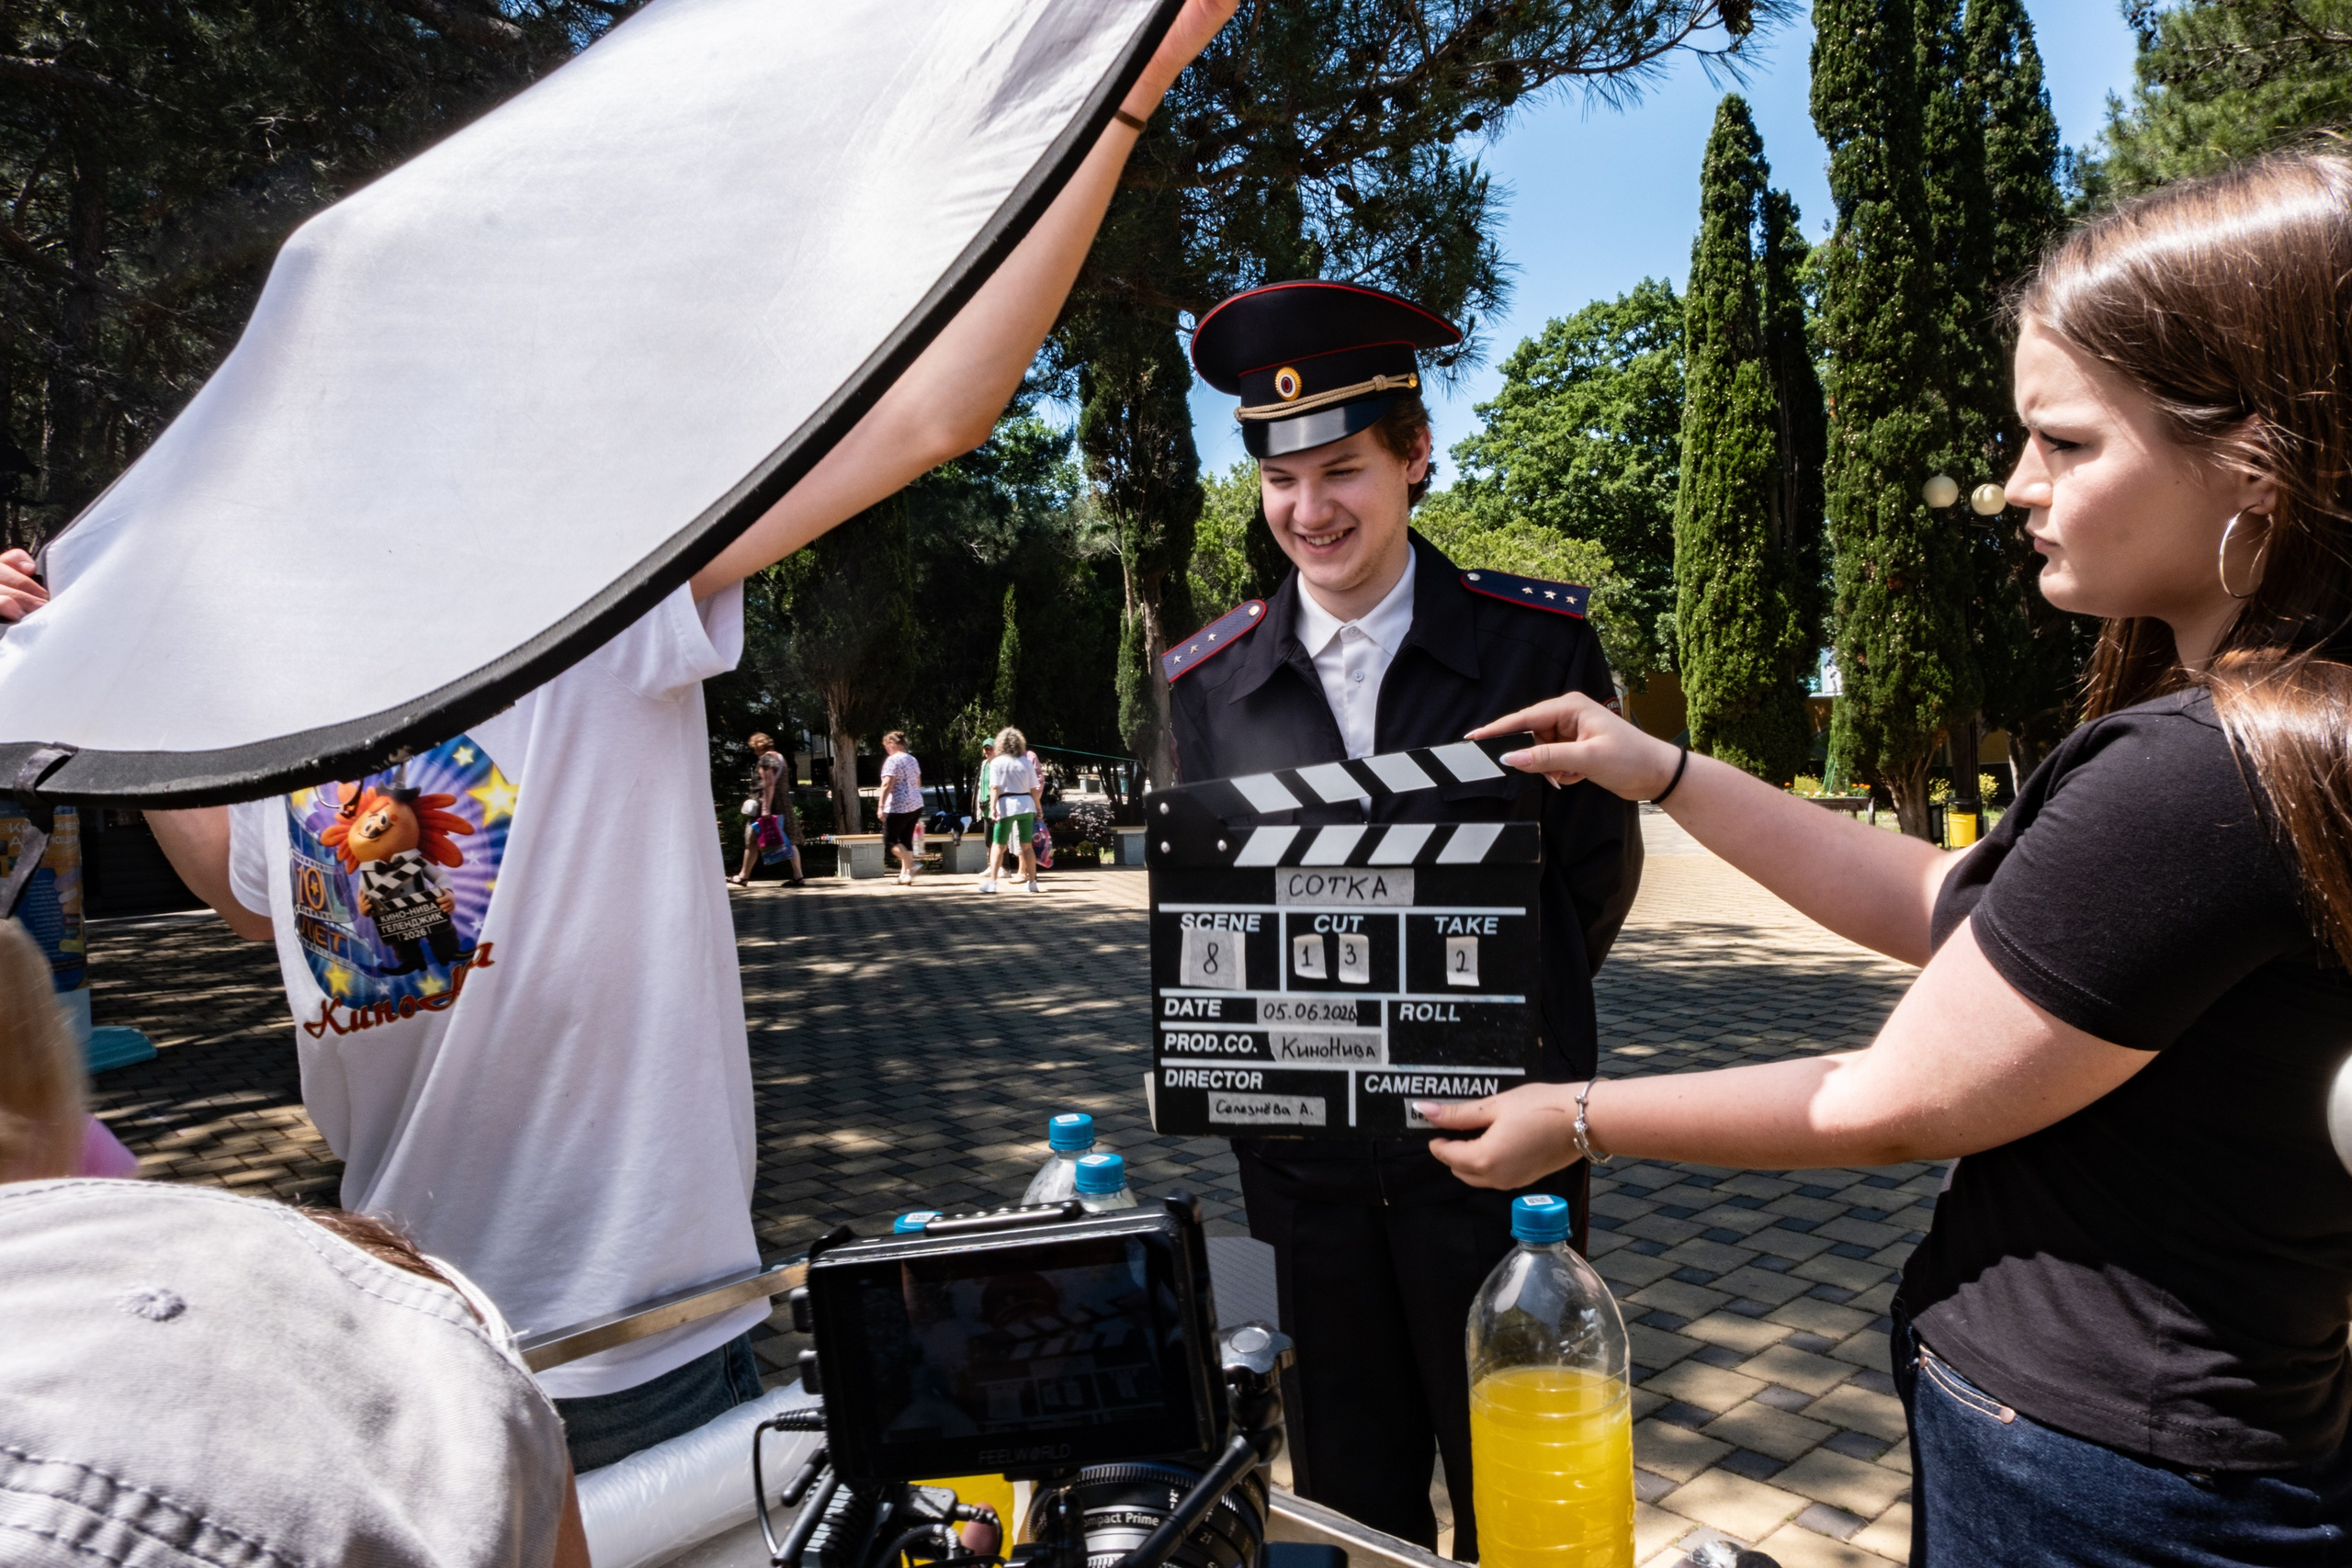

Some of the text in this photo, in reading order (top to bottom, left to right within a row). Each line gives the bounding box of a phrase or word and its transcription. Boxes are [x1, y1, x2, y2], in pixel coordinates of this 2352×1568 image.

[297, 865, 325, 910] 10
[1289, 874, 1388, 900] СОТКА
[379, 902, 438, 923] КИНО-НИВА
[380, 912, 444, 934] ГЕЛЕНДЖИК
[1180, 913, 1261, 932] SCENE
[402, 928, 427, 941] 2026
[1314, 915, 1364, 933] CUT
[1434, 917, 1499, 935] TAKE
[1203, 942, 1219, 976] 8
[1301, 943, 1357, 967] 1 3
[1455, 950, 1470, 973] 2
[1164, 998, 1222, 1018] DATE
[1263, 1002, 1357, 1021] 05.06.2026
[1399, 1002, 1461, 1022] ROLL
[1164, 1032, 1258, 1054] PROD.CO.
[1164, 1068, 1263, 1090] DIRECTOR
[1364, 1074, 1498, 1096] CAMERAMAN
[1083, 1512, 1159, 1528] ompact Prime
